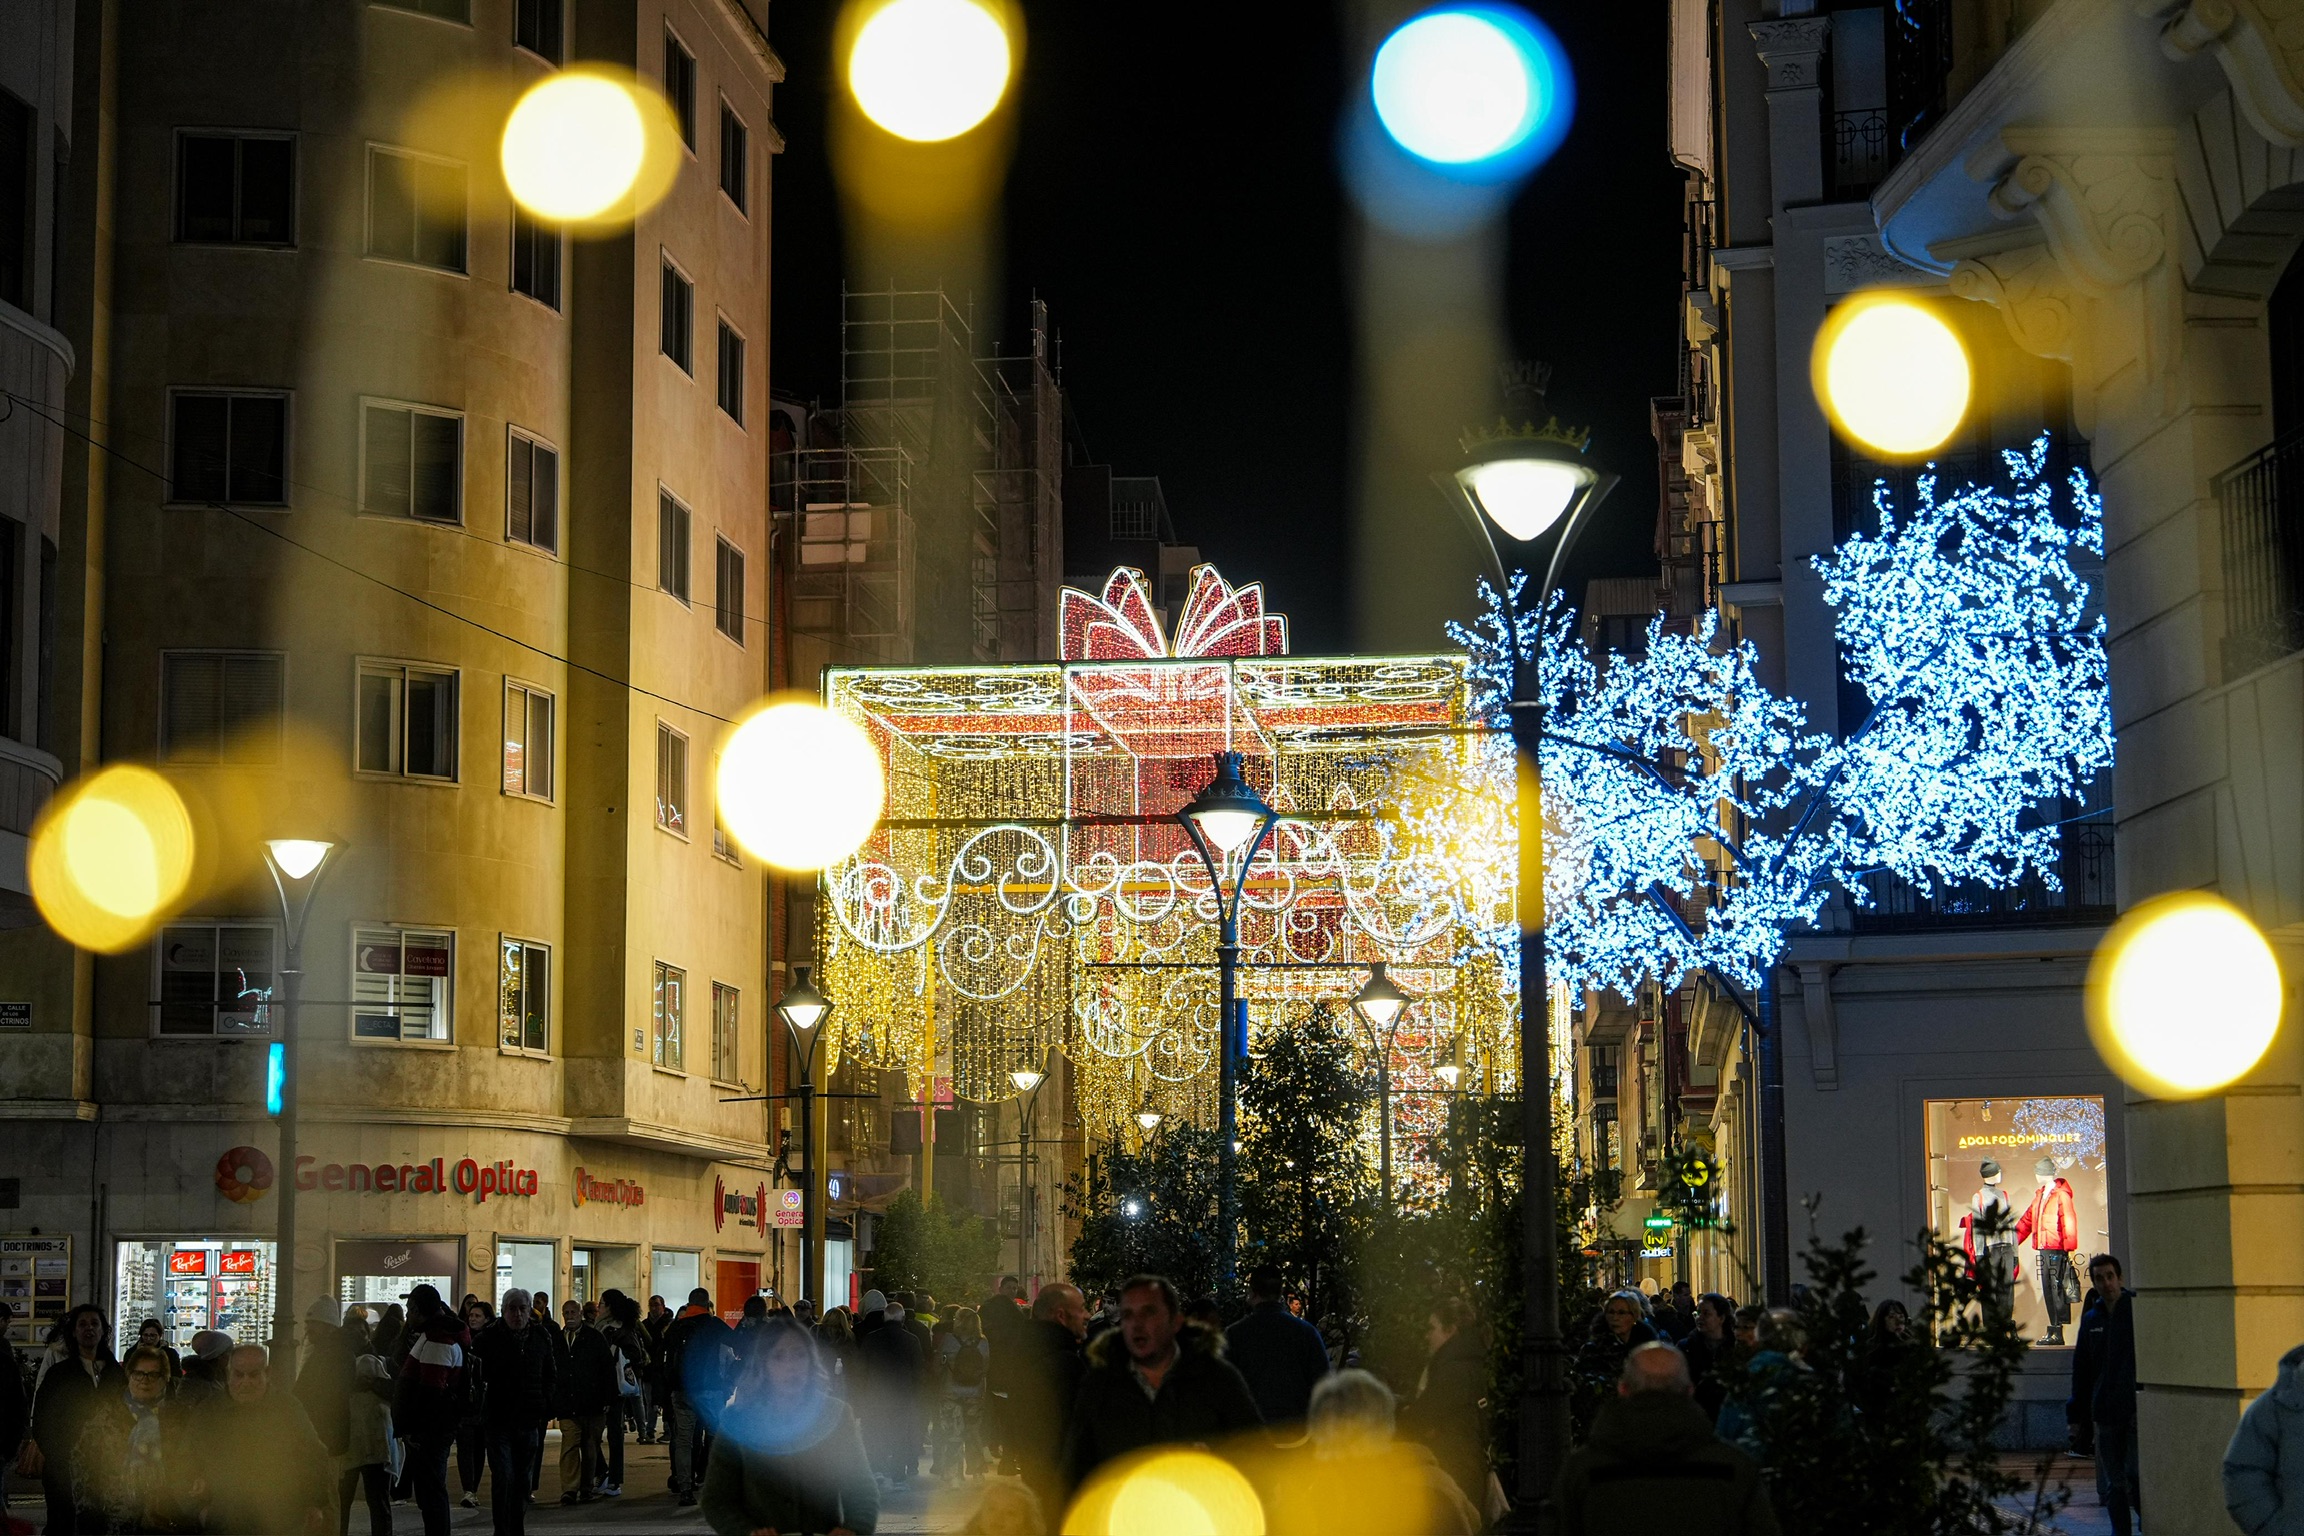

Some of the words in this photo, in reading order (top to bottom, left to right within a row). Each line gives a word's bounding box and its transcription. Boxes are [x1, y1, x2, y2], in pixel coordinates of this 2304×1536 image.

[295, 1155, 447, 1193] General
[455, 1158, 538, 1203] Optica
[778, 1218, 804, 1226] Optica
[384, 1251, 412, 1269] Persol
